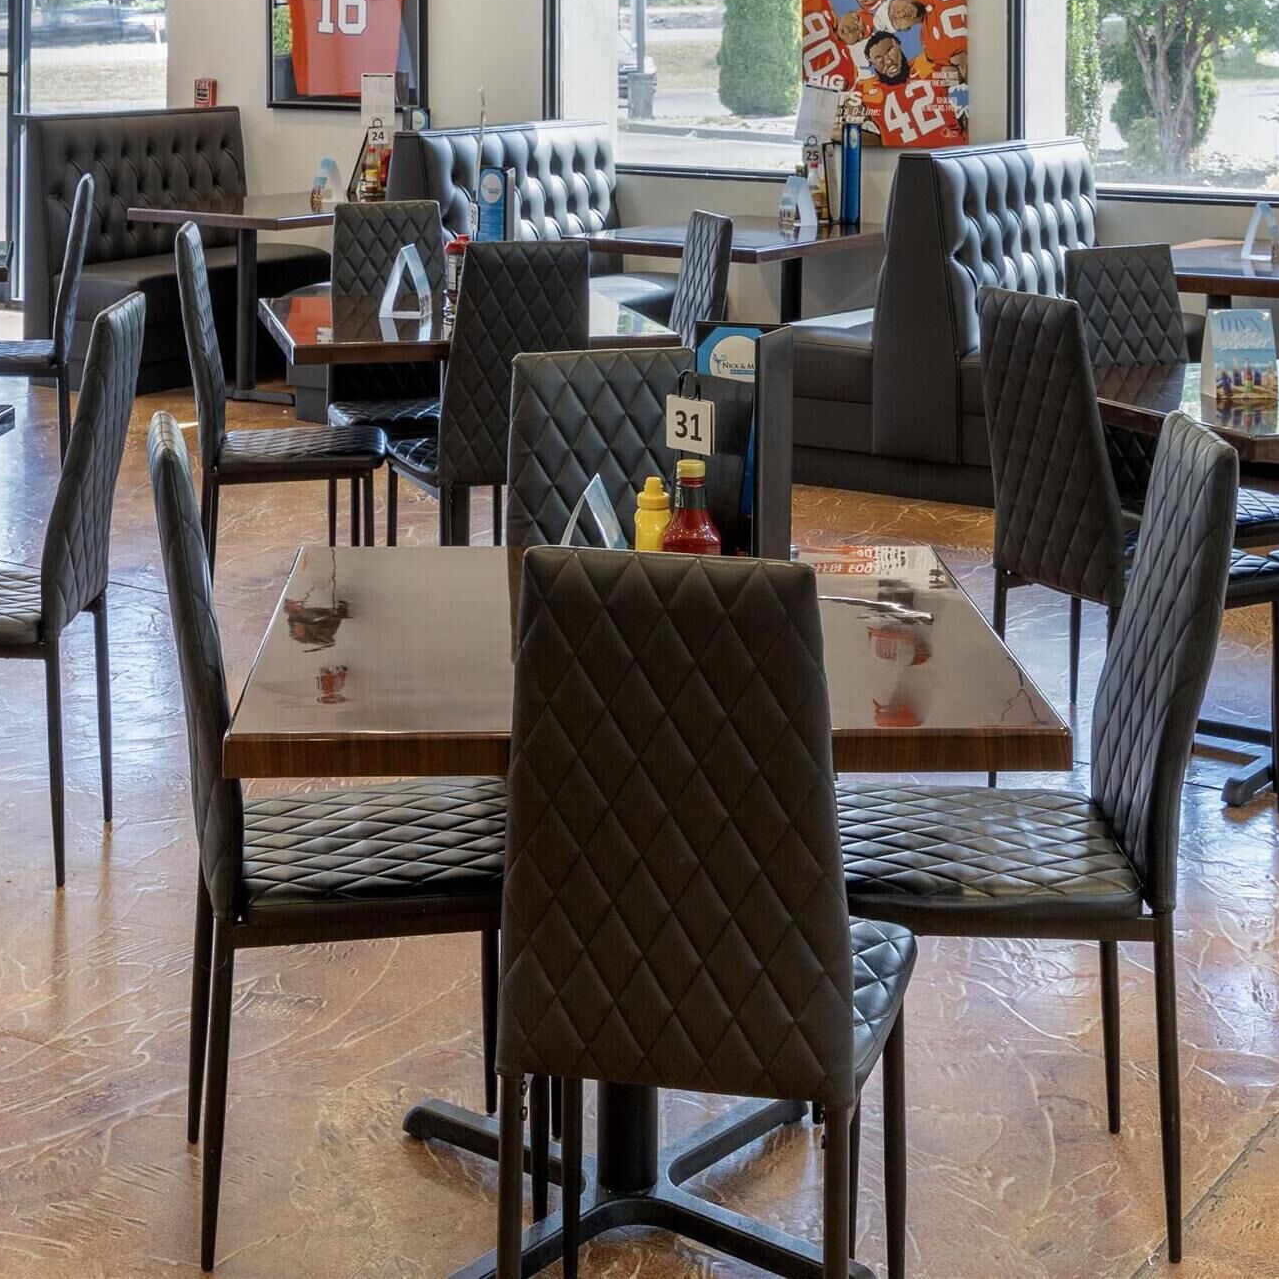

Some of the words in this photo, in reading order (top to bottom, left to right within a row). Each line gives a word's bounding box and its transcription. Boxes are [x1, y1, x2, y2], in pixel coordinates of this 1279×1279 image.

[808, 75, 845, 91] BIG
[852, 107, 881, 116] D-Line:
[885, 79, 945, 144] 42
[372, 131, 384, 141] 24
[806, 146, 819, 161] 25
[722, 362, 742, 370] NICK
[675, 410, 703, 442] 31
